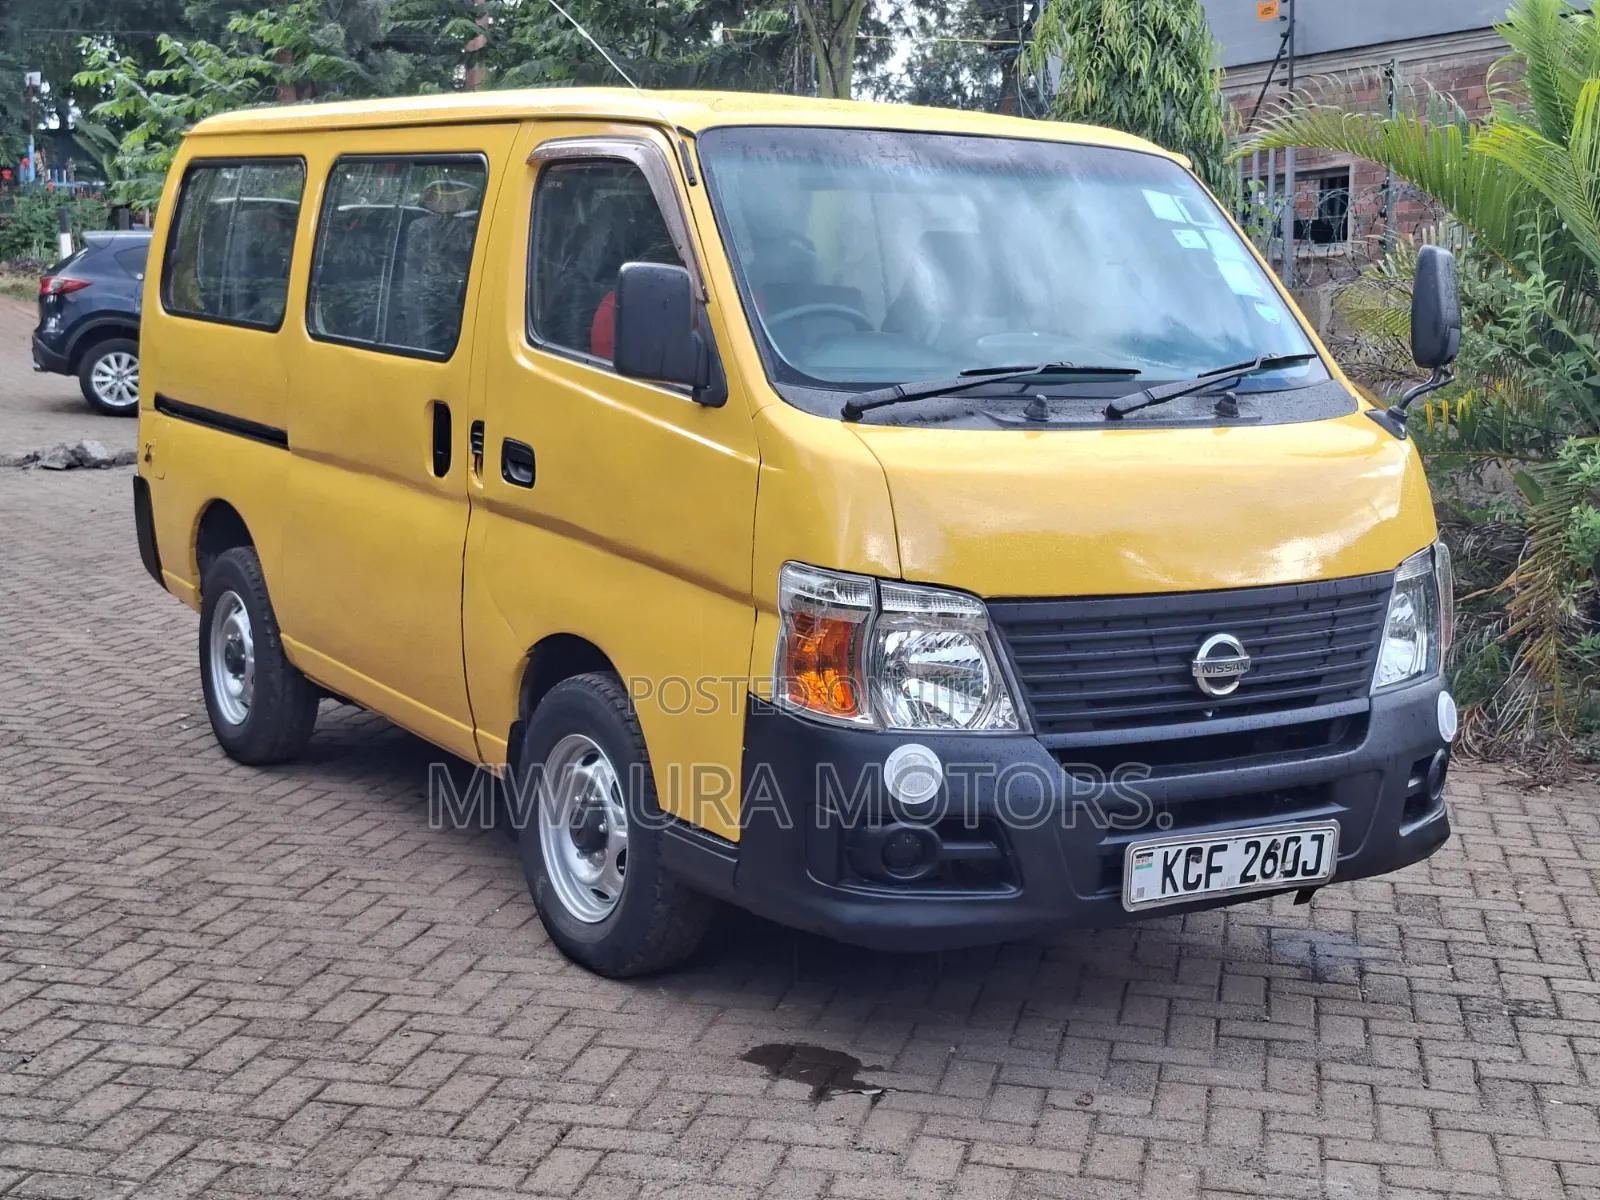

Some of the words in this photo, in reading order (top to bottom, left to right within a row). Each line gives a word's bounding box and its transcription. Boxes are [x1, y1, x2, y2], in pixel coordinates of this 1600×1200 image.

[1202, 662, 1249, 674] NISSAN
[1161, 844, 1228, 895] KCF
[1239, 833, 1325, 885] 260J
